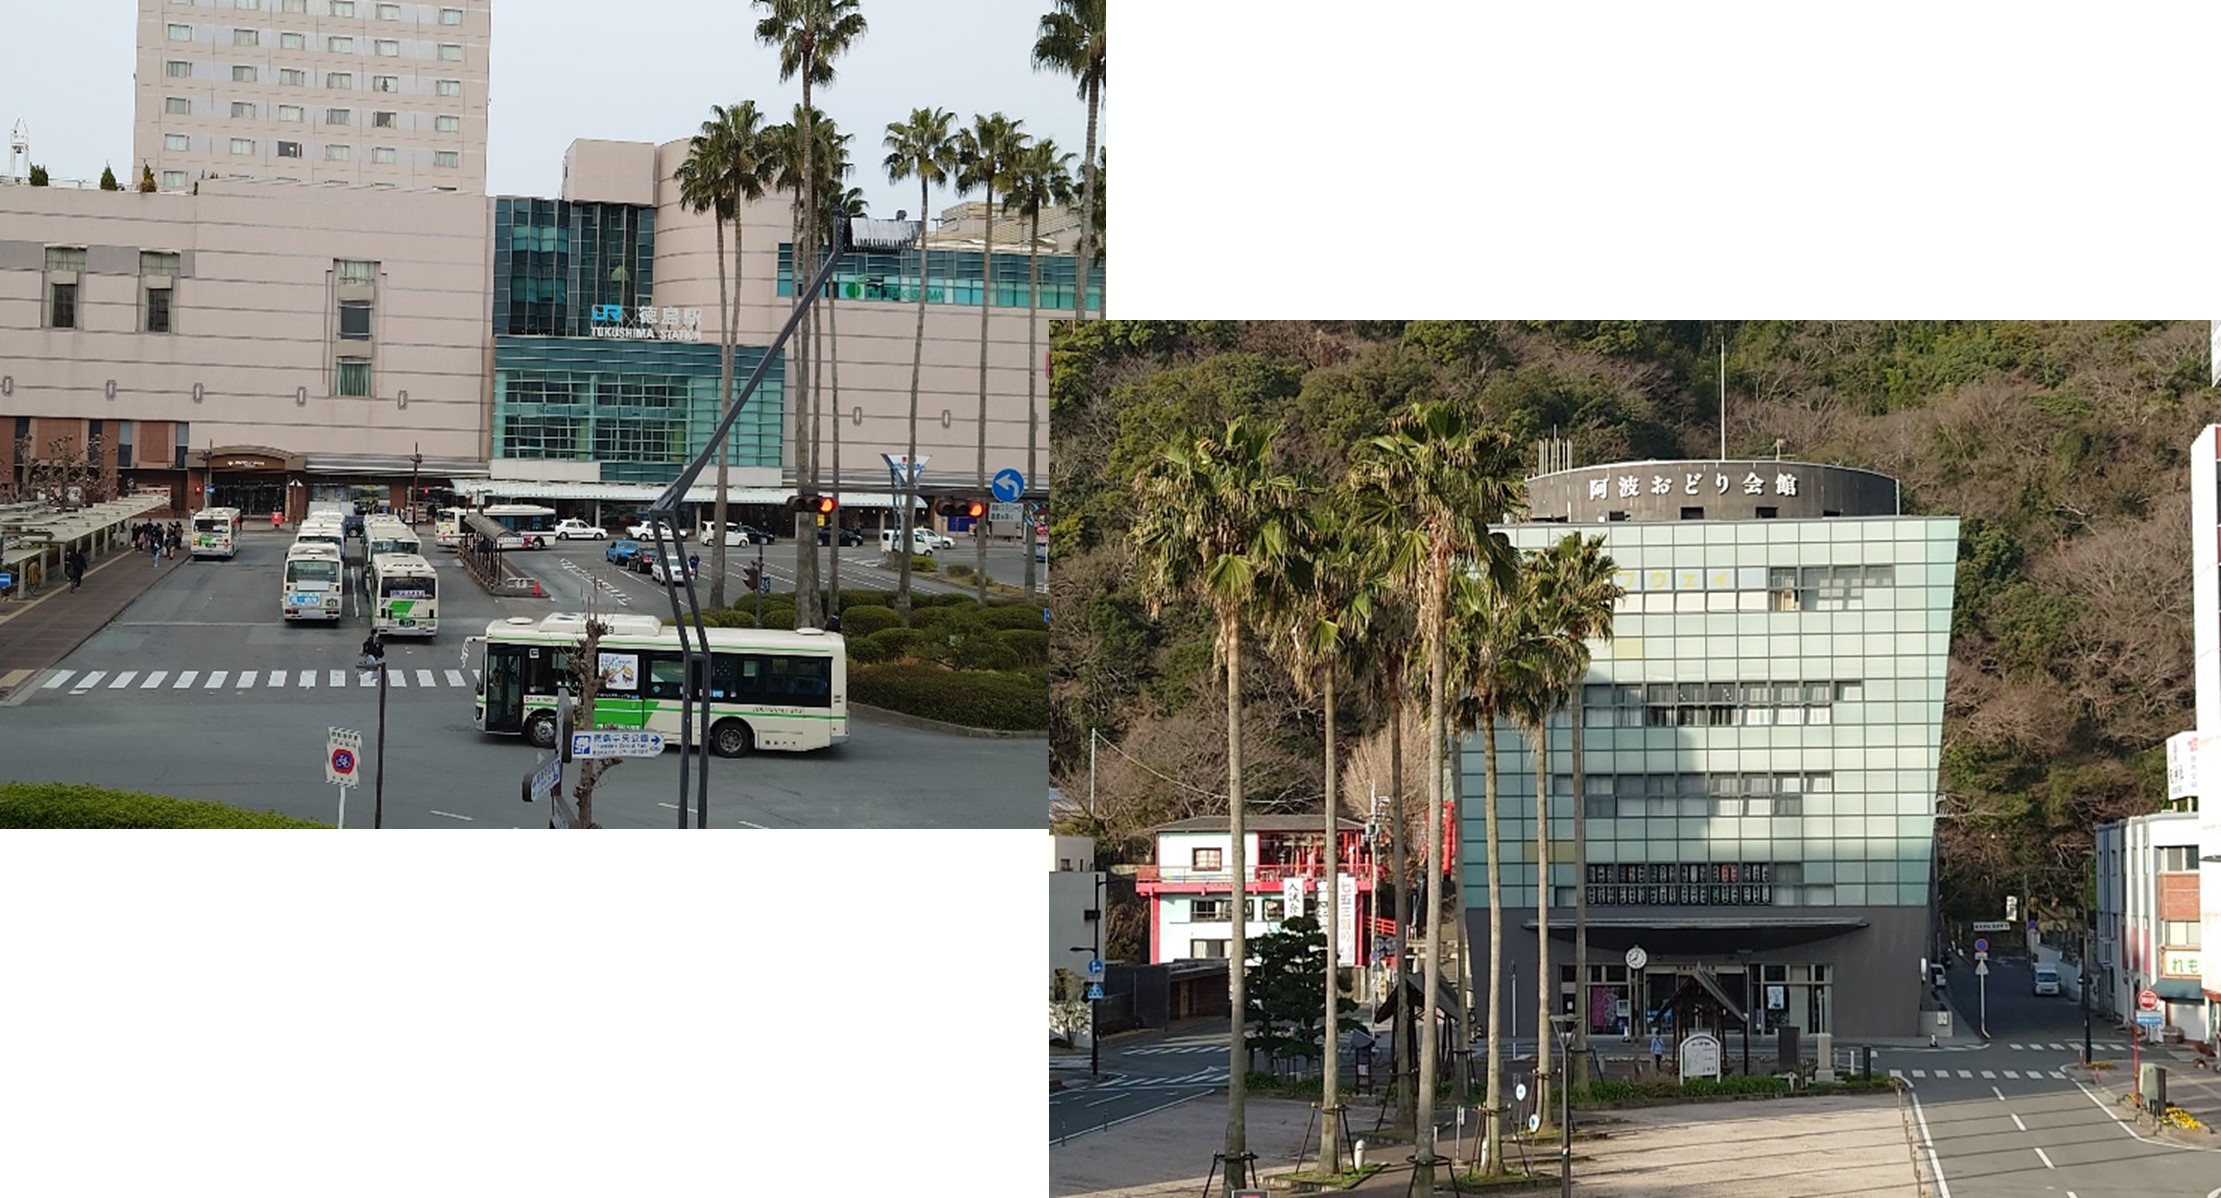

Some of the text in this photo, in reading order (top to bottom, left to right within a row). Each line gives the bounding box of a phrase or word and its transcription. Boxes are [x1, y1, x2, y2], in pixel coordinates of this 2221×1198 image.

[592, 304, 702, 328] JR 徳島駅
[590, 325, 655, 339] TOKUSHIMA
[1588, 472, 1798, 500] 阿波おどり会館
